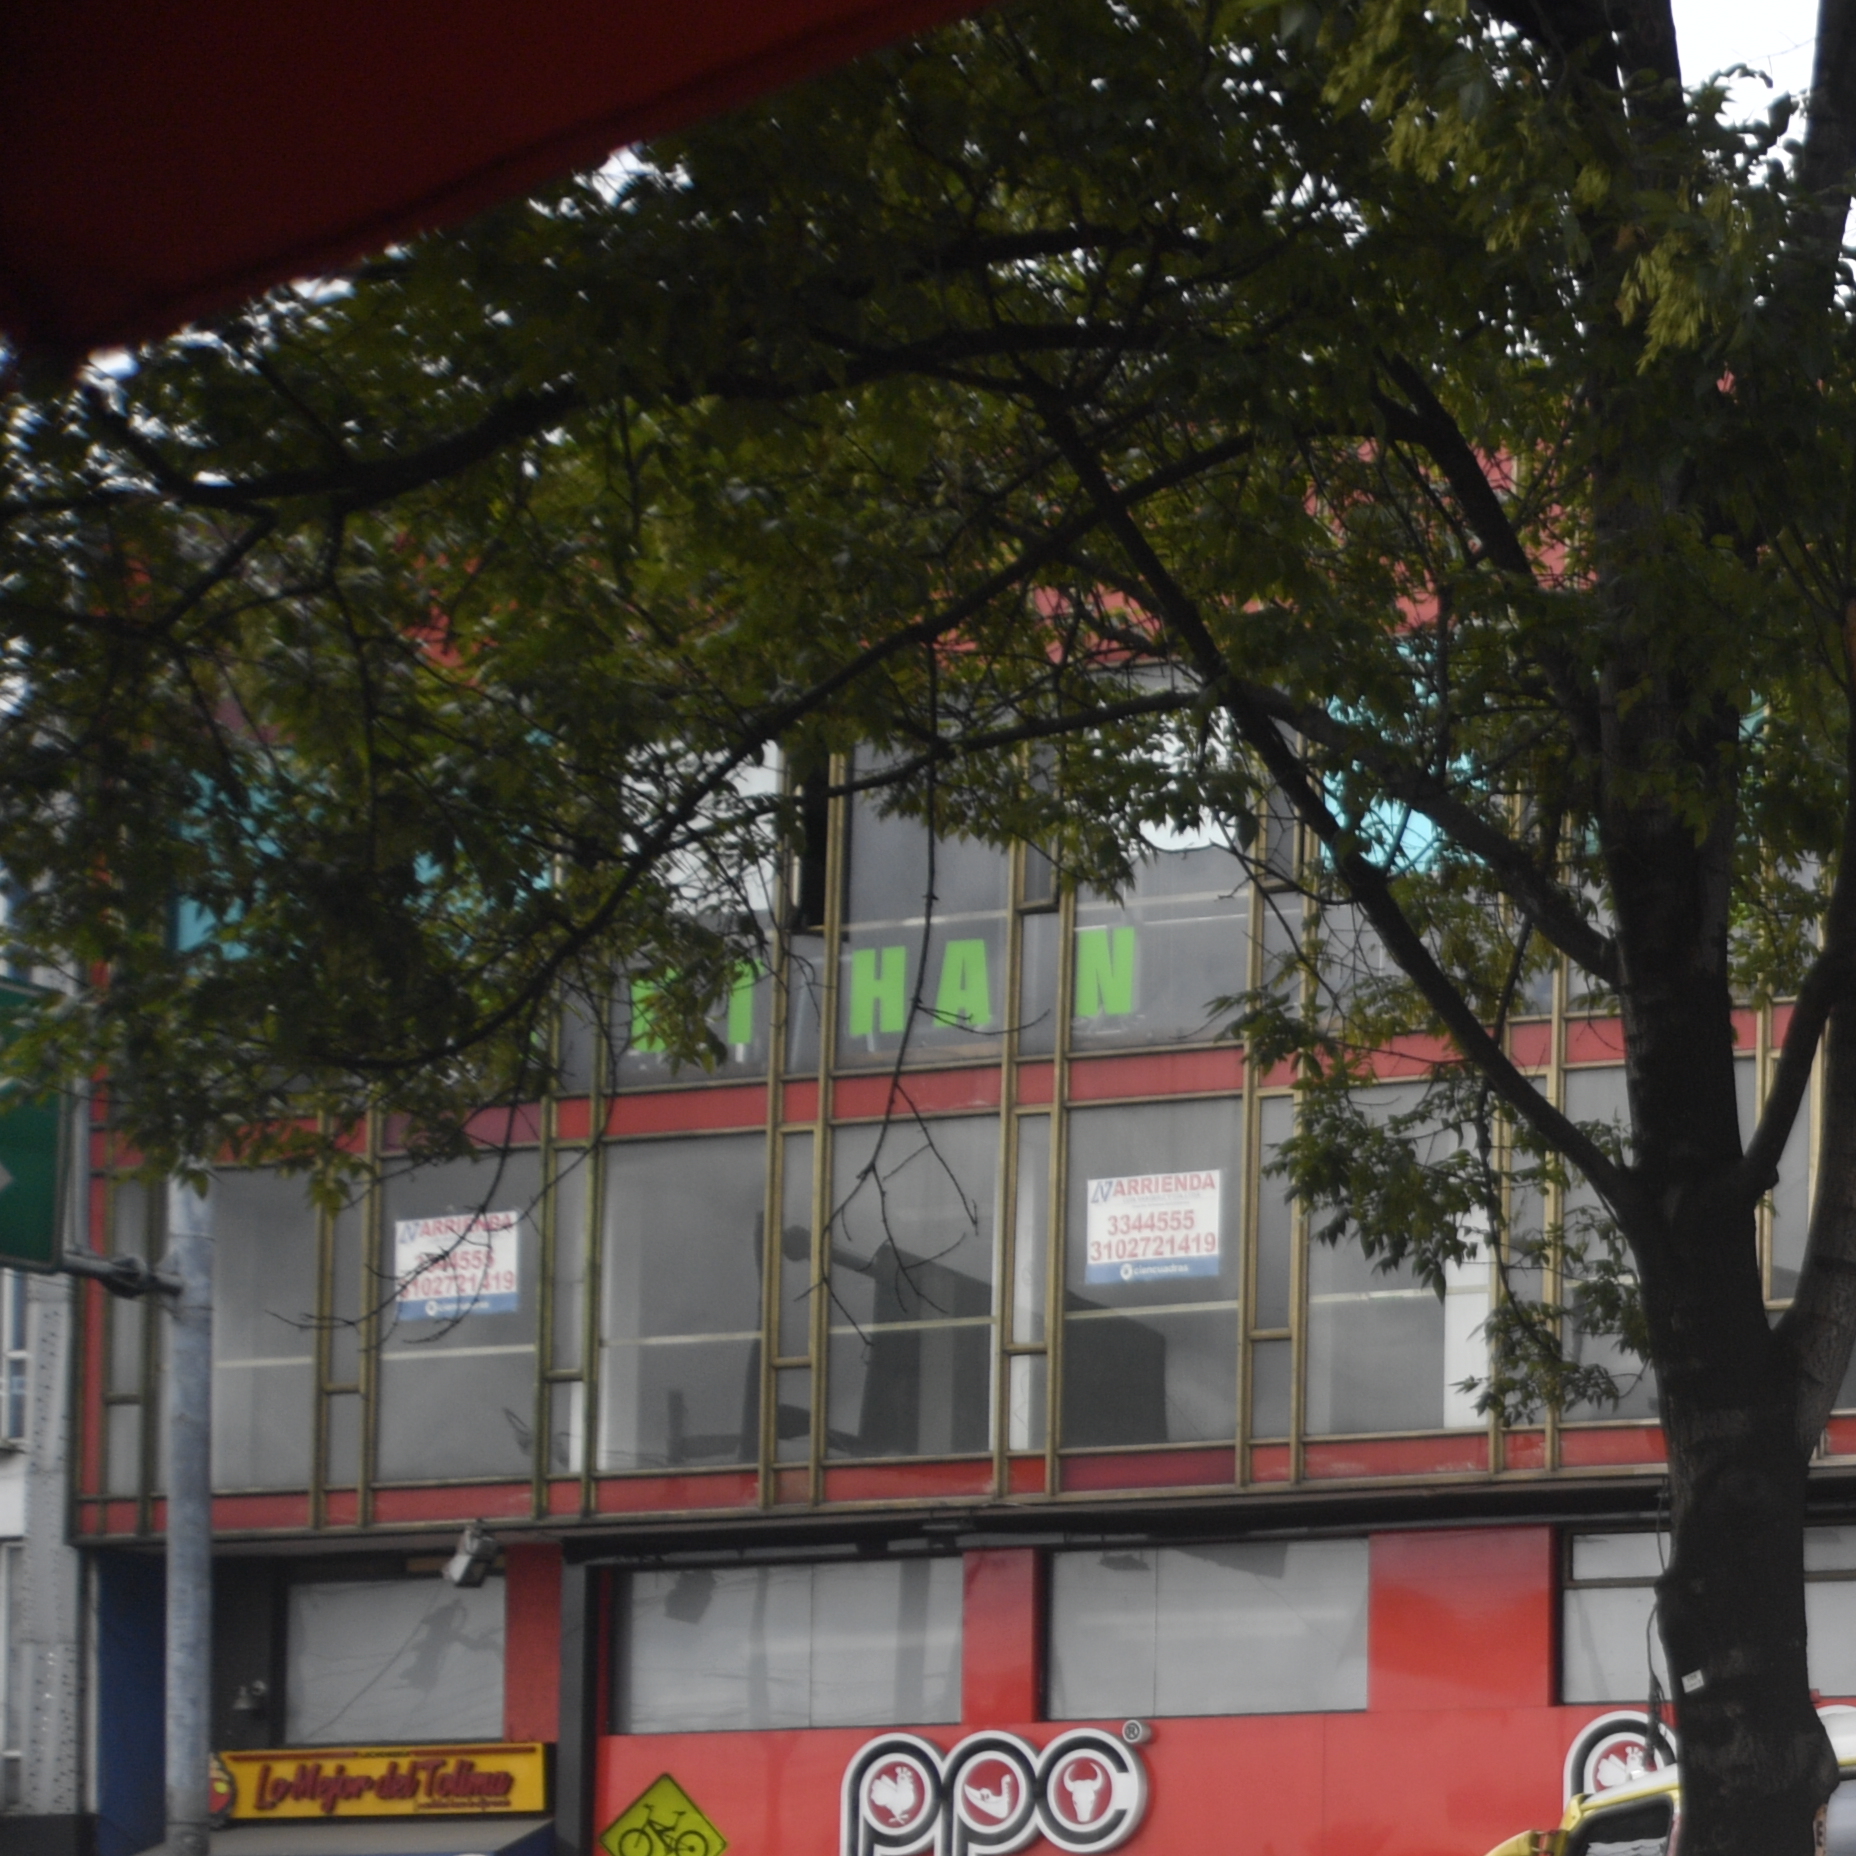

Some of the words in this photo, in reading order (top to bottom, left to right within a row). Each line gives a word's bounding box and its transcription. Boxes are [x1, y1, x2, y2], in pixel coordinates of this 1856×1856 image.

[1113, 1172, 1216, 1197] ARRIENDA
[1108, 1209, 1195, 1236] 3344555
[1091, 1233, 1216, 1261] 3102721419
